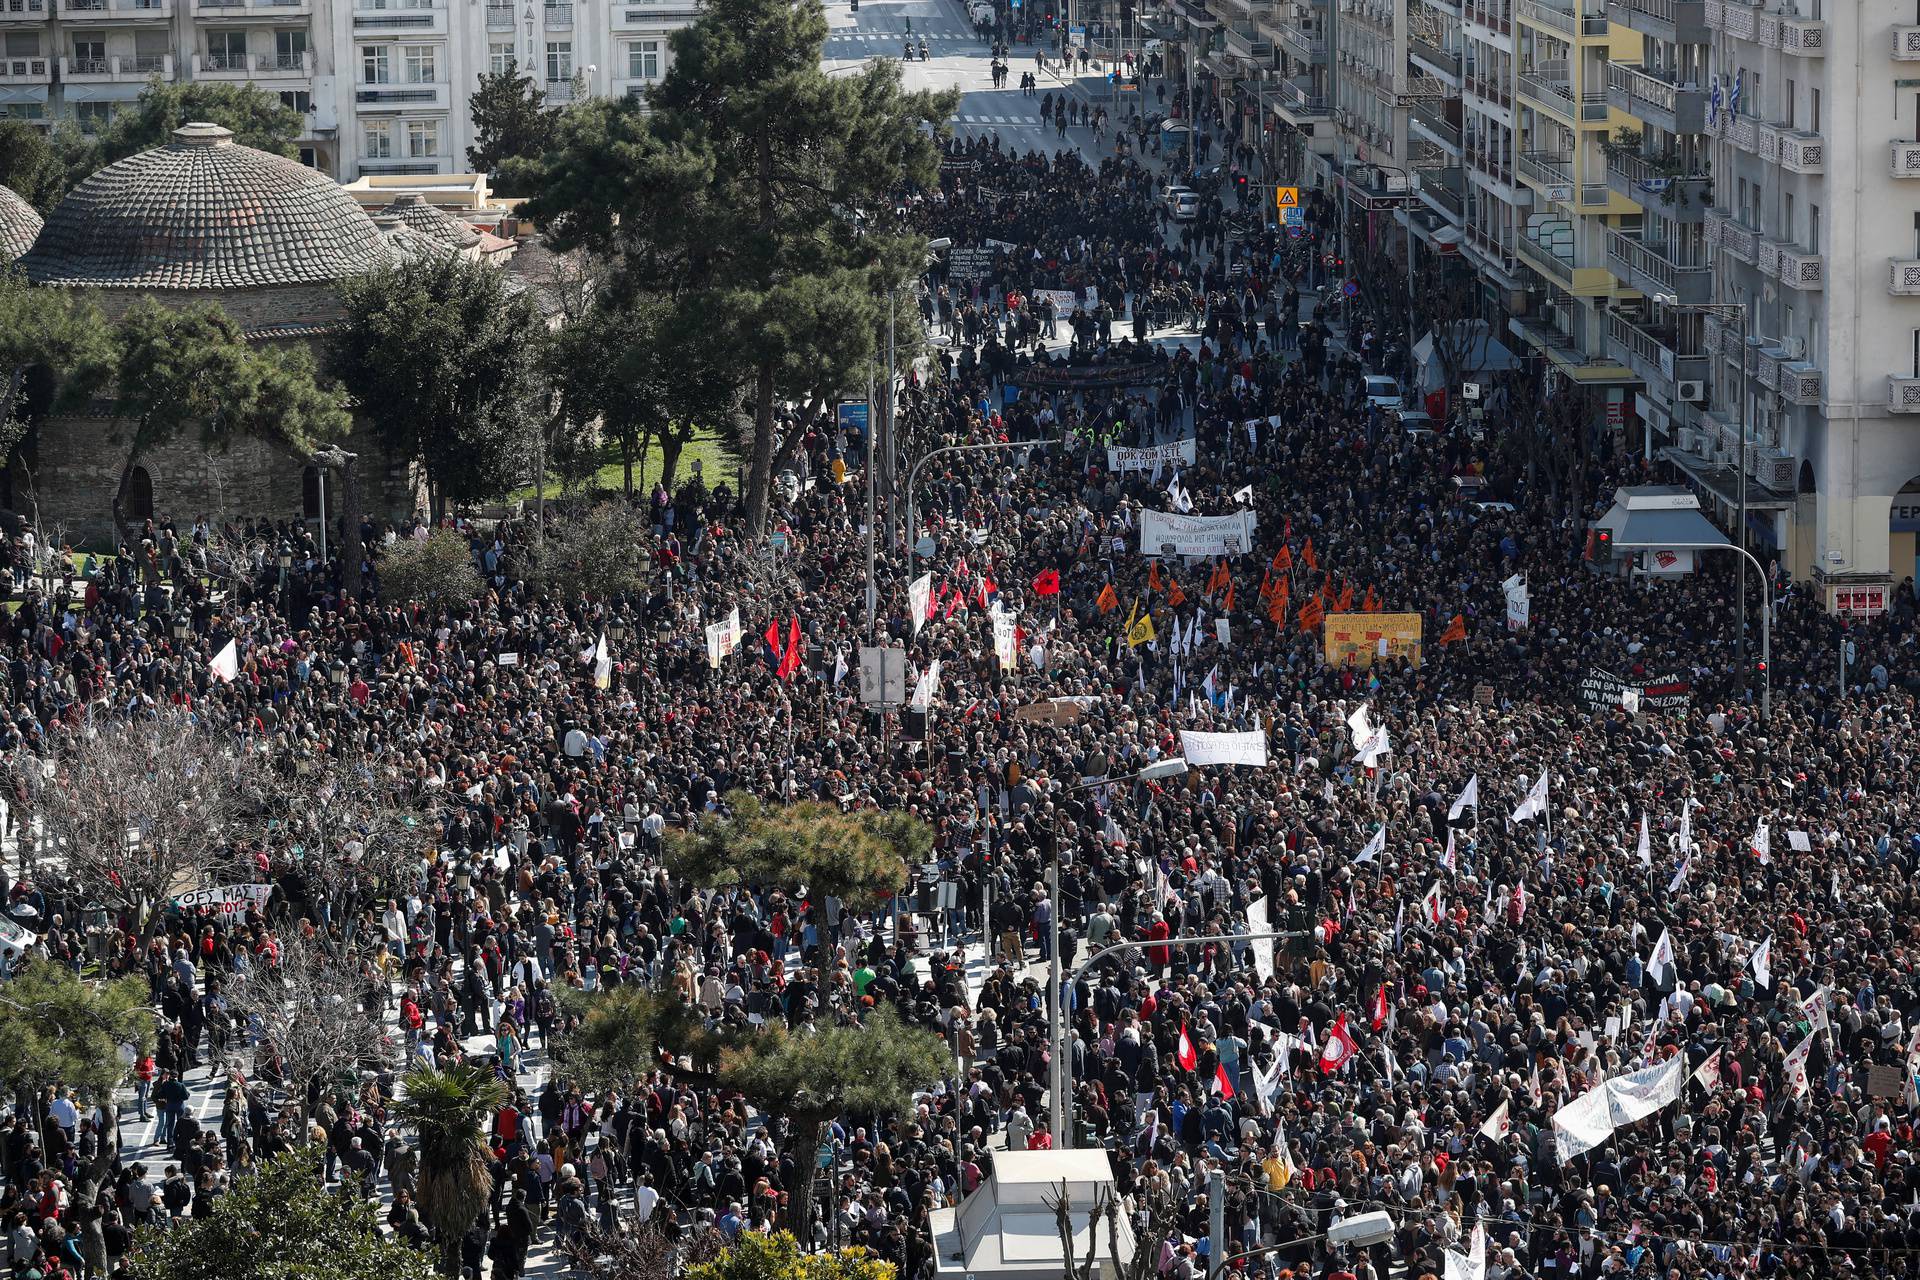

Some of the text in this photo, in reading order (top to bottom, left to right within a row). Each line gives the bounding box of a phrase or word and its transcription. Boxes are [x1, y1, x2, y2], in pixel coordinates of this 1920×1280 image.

[1581, 679, 1601, 690] ΔΕΝ
[1604, 682, 1615, 692] ΘΑ
[1583, 690, 1598, 701] ΝΑ
[1601, 693, 1623, 704] ΜΗΝ
[1589, 701, 1610, 712] ΤΟΝ
[222, 885, 255, 902] ΜΑΣ
